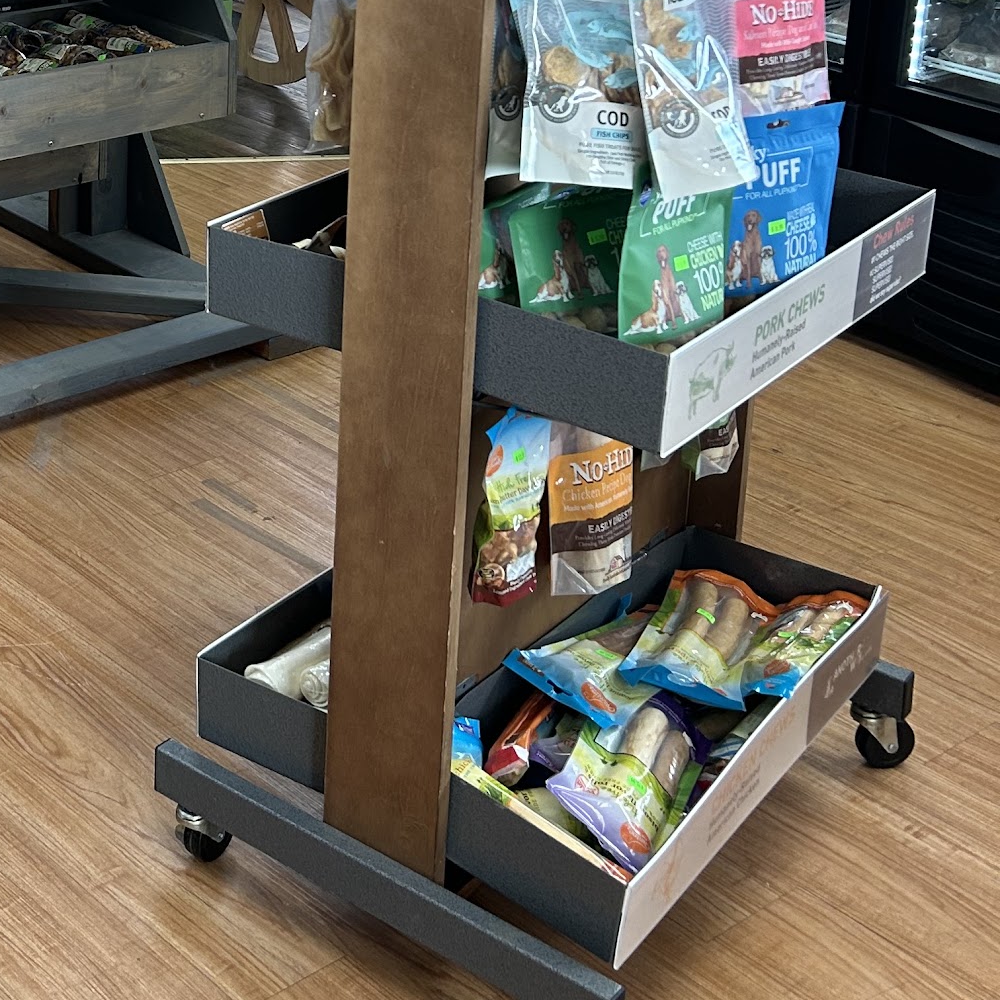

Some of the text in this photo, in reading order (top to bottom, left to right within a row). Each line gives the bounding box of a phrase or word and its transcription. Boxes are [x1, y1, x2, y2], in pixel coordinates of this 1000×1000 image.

[598, 110, 629, 126] COD
[612, 132, 630, 140] CHIPS
[745, 192, 760, 200] FOR
[762, 190, 773, 198] ALL
[786, 216, 812, 236] CHEESE
[874, 214, 914, 249] Chew Rules
[687, 236, 708, 253] CHEESE
[785, 229, 818, 260] 100%
[690, 247, 718, 270] CHICKEN
[754, 309, 786, 346] PORK
[788, 284, 826, 324] CHEWS
[752, 318, 806, 363] Humanely-Raised
[750, 341, 796, 380] American Pork
[562, 482, 600, 502] Chicken
[564, 503, 580, 512] Made
[581, 501, 594, 512] with
[588, 518, 612, 534] EASILY
